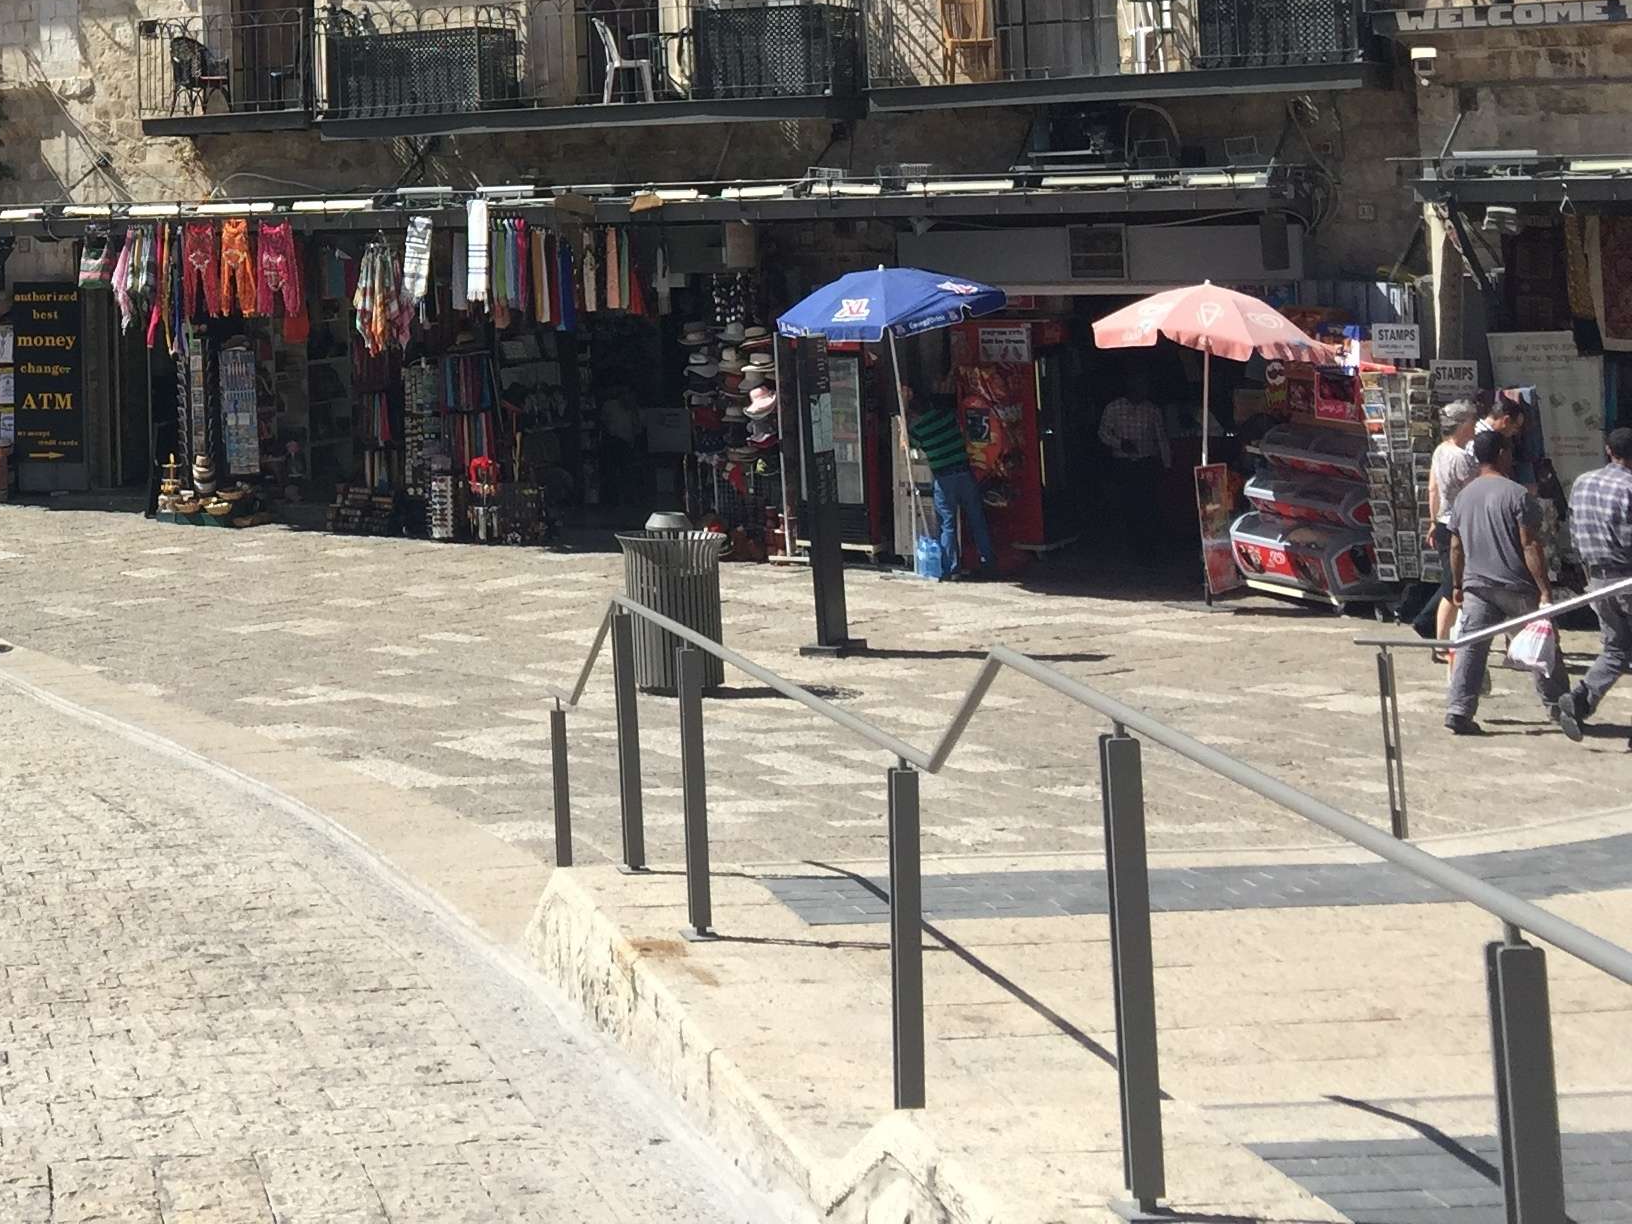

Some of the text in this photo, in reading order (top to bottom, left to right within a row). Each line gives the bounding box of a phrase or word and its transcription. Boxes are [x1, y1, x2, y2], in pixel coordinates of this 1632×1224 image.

[1395, 0, 1609, 31] WELCOME
[14, 291, 78, 302] authorized
[32, 309, 58, 319] best
[1378, 329, 1416, 341] STAMPS
[17, 335, 77, 350] money
[20, 362, 71, 376] changer
[1435, 366, 1473, 381] STAMPS
[21, 392, 73, 410] ATM
